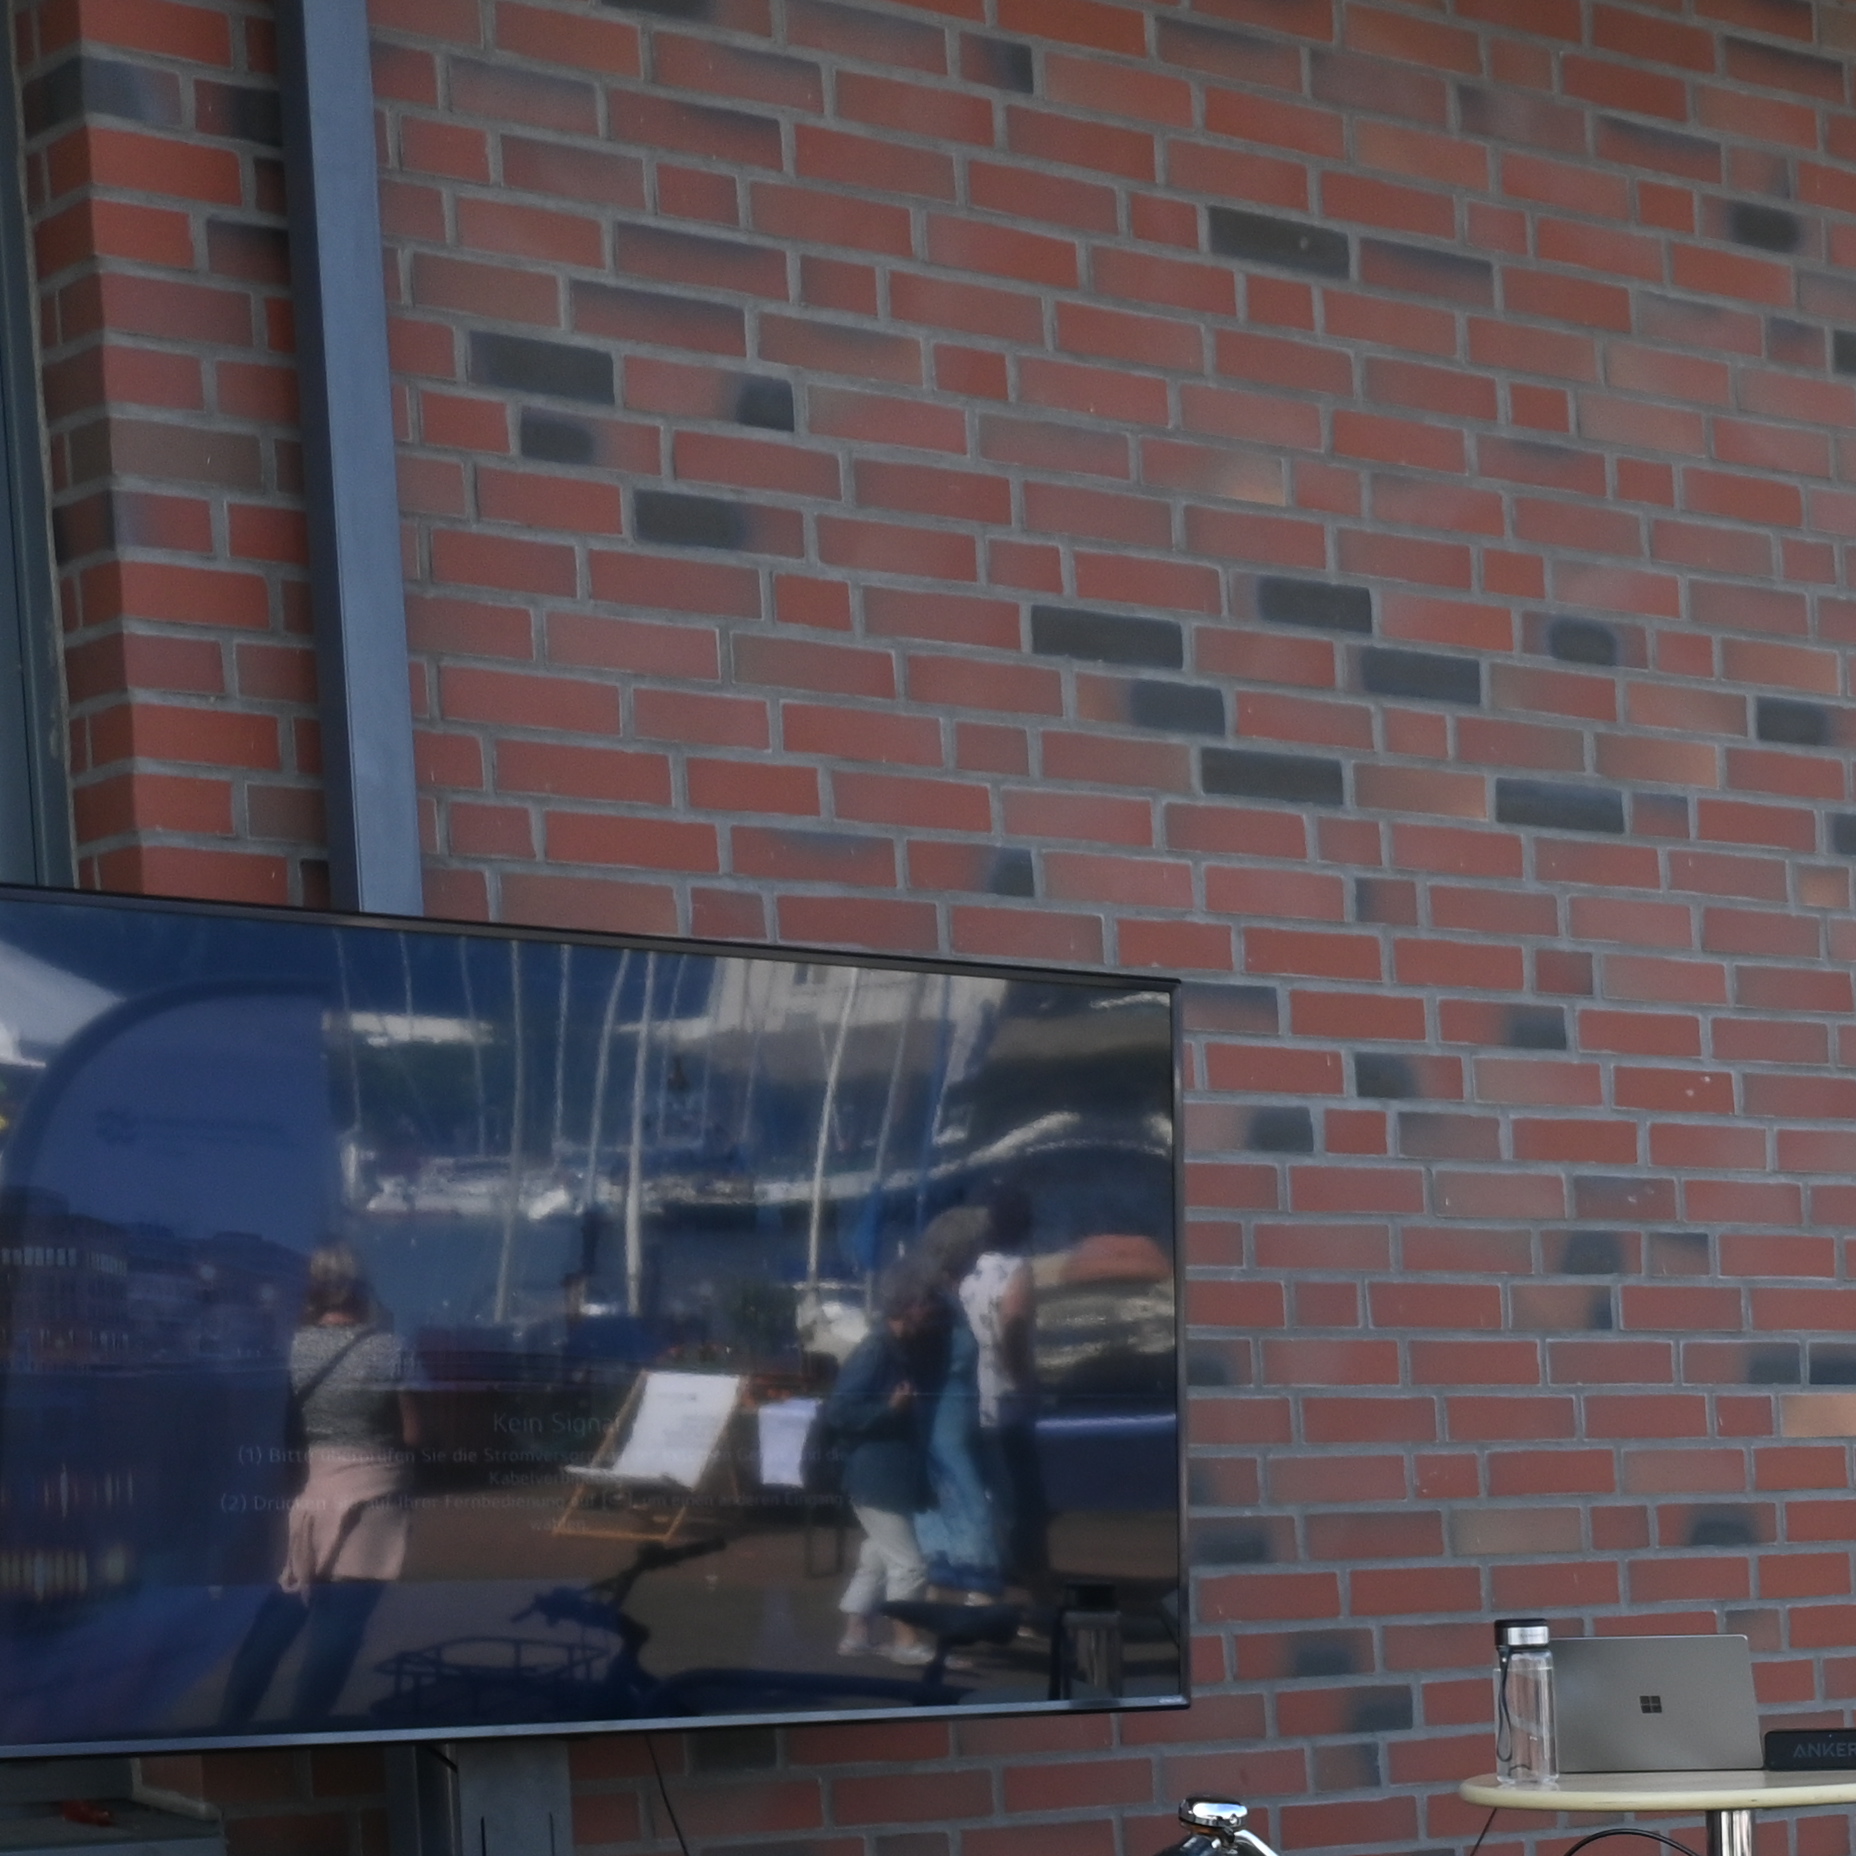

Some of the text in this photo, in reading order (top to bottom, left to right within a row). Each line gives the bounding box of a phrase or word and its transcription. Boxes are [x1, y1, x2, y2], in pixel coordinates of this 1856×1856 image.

[493, 1411, 543, 1433] Kein
[420, 1447, 447, 1463] Sie
[452, 1447, 477, 1463] die
